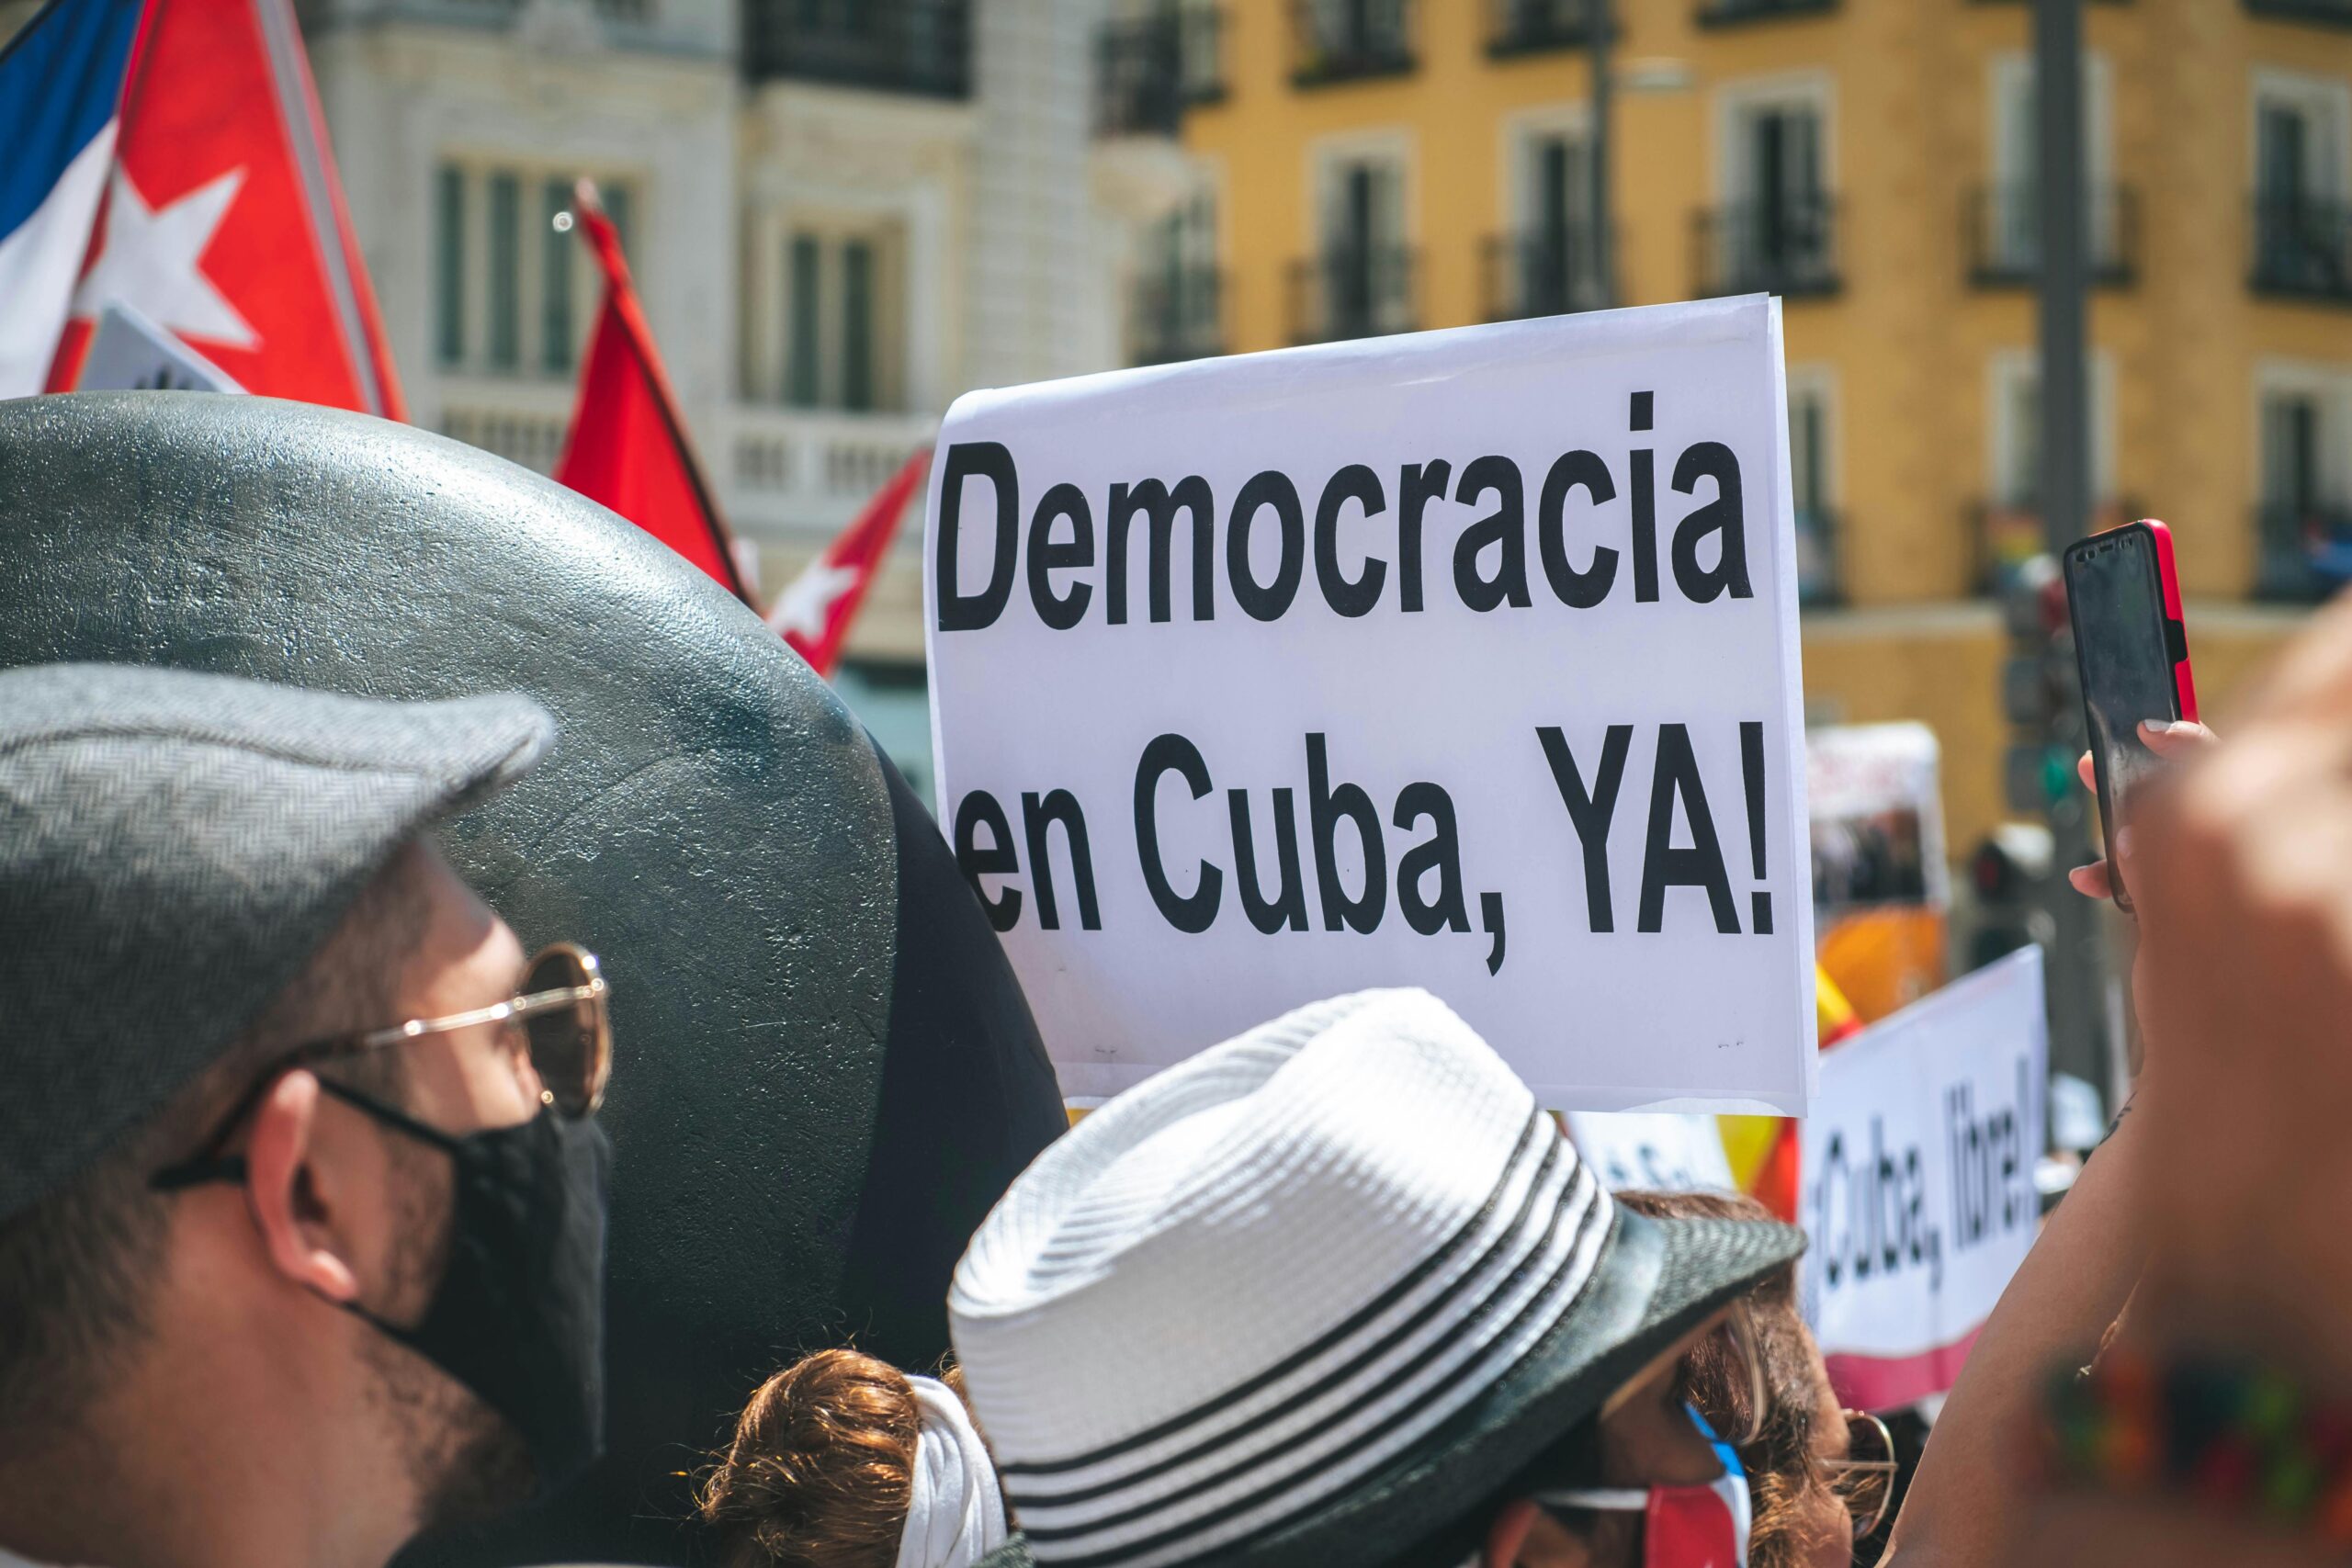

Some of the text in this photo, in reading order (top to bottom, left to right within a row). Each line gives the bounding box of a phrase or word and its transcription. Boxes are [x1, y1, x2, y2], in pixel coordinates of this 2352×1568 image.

[936, 390, 1754, 632] Democracia
[954, 721, 1774, 977] en Cuba, YA!
